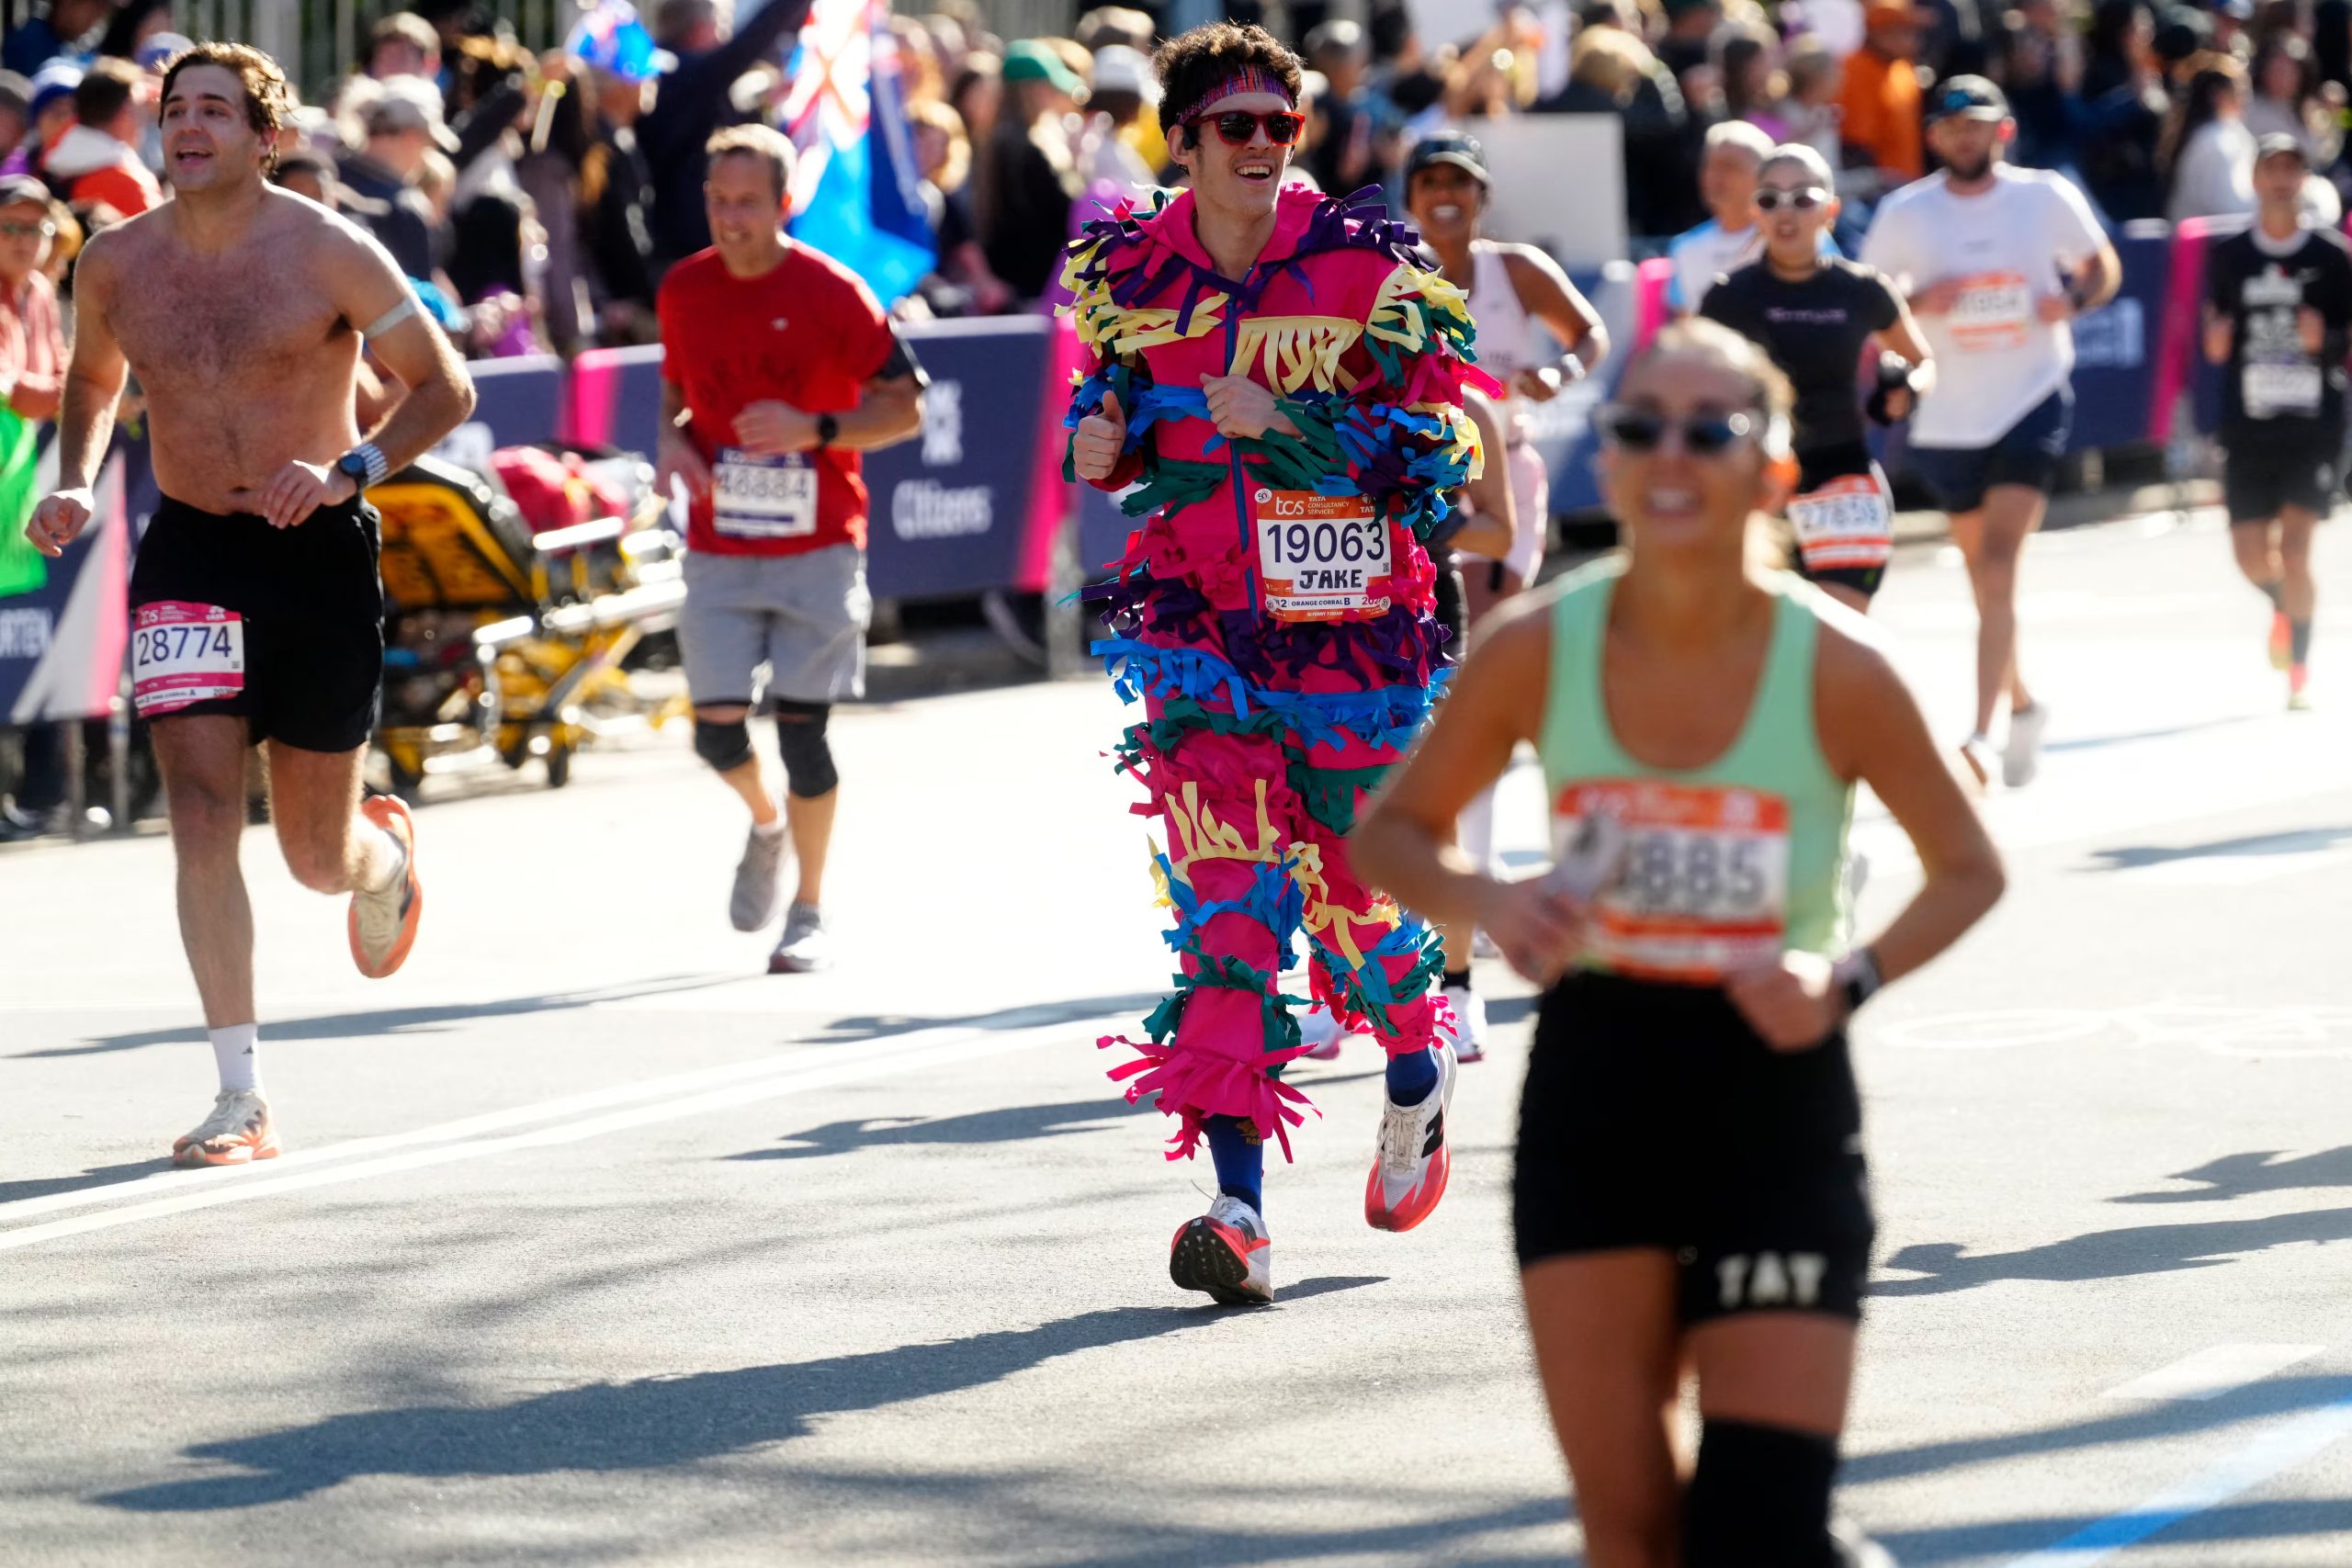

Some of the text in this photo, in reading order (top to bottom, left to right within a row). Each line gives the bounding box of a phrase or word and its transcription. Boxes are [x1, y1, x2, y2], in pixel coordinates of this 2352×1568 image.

[1275, 496, 1305, 515] tcs
[1267, 523, 1385, 564] 19063
[1299, 570, 1363, 589] JAKE
[1281, 599, 1287, 608] 2
[1343, 597, 1351, 606] B
[138, 626, 232, 666] 28774
[1619, 833, 1765, 908] 885
